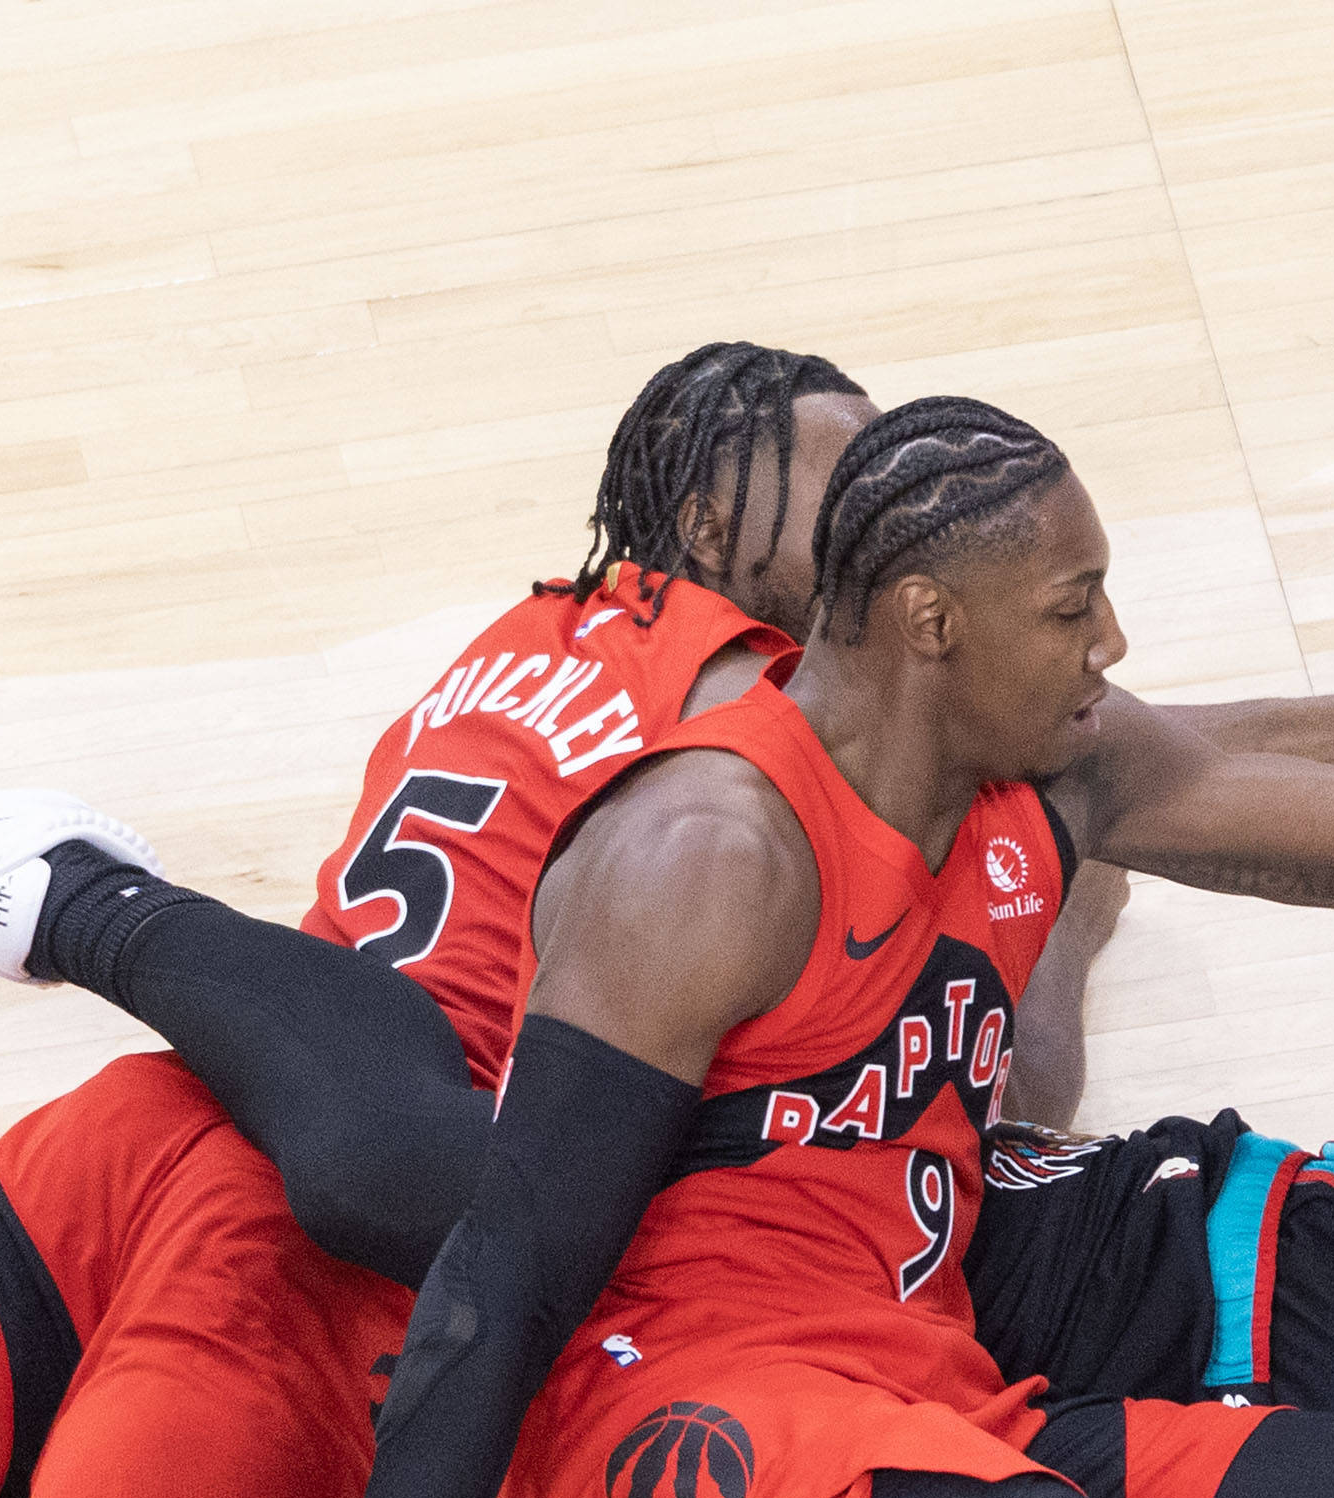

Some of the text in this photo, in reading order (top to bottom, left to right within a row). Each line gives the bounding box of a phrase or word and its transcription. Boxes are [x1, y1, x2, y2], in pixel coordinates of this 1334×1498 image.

[337, 769, 507, 968] 5
[988, 892, 1044, 921] Sun Life
[900, 1149, 954, 1303] 9
